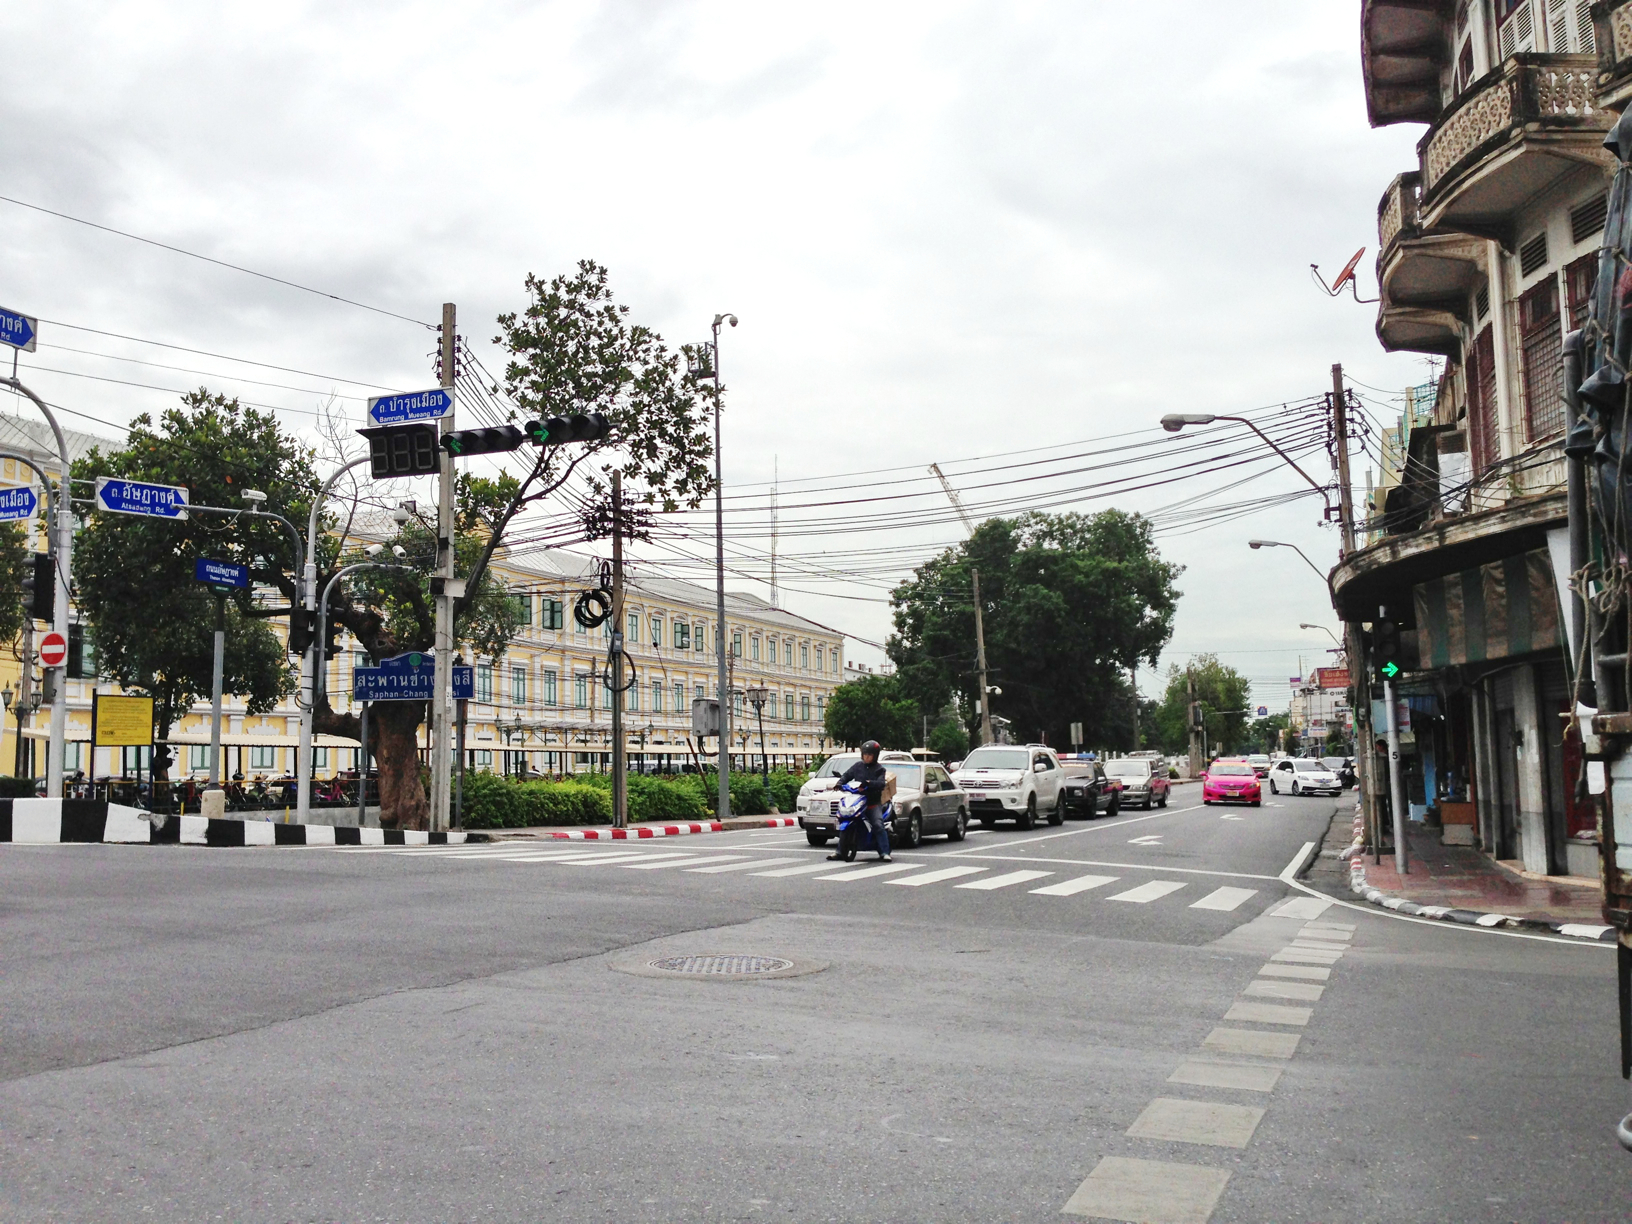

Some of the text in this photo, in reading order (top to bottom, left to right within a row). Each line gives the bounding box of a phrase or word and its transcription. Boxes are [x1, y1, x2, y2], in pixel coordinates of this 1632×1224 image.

[389, 393, 443, 413] บำรุงเมือง
[379, 415, 405, 423] Bamrung
[408, 411, 430, 419] Mueang
[111, 483, 176, 505] ถ. อัษฎางค์
[121, 502, 166, 514] Atsadang Rd.
[369, 690, 399, 699] Saphan
[403, 689, 429, 699] Chang
[1392, 751, 1399, 760] 5
